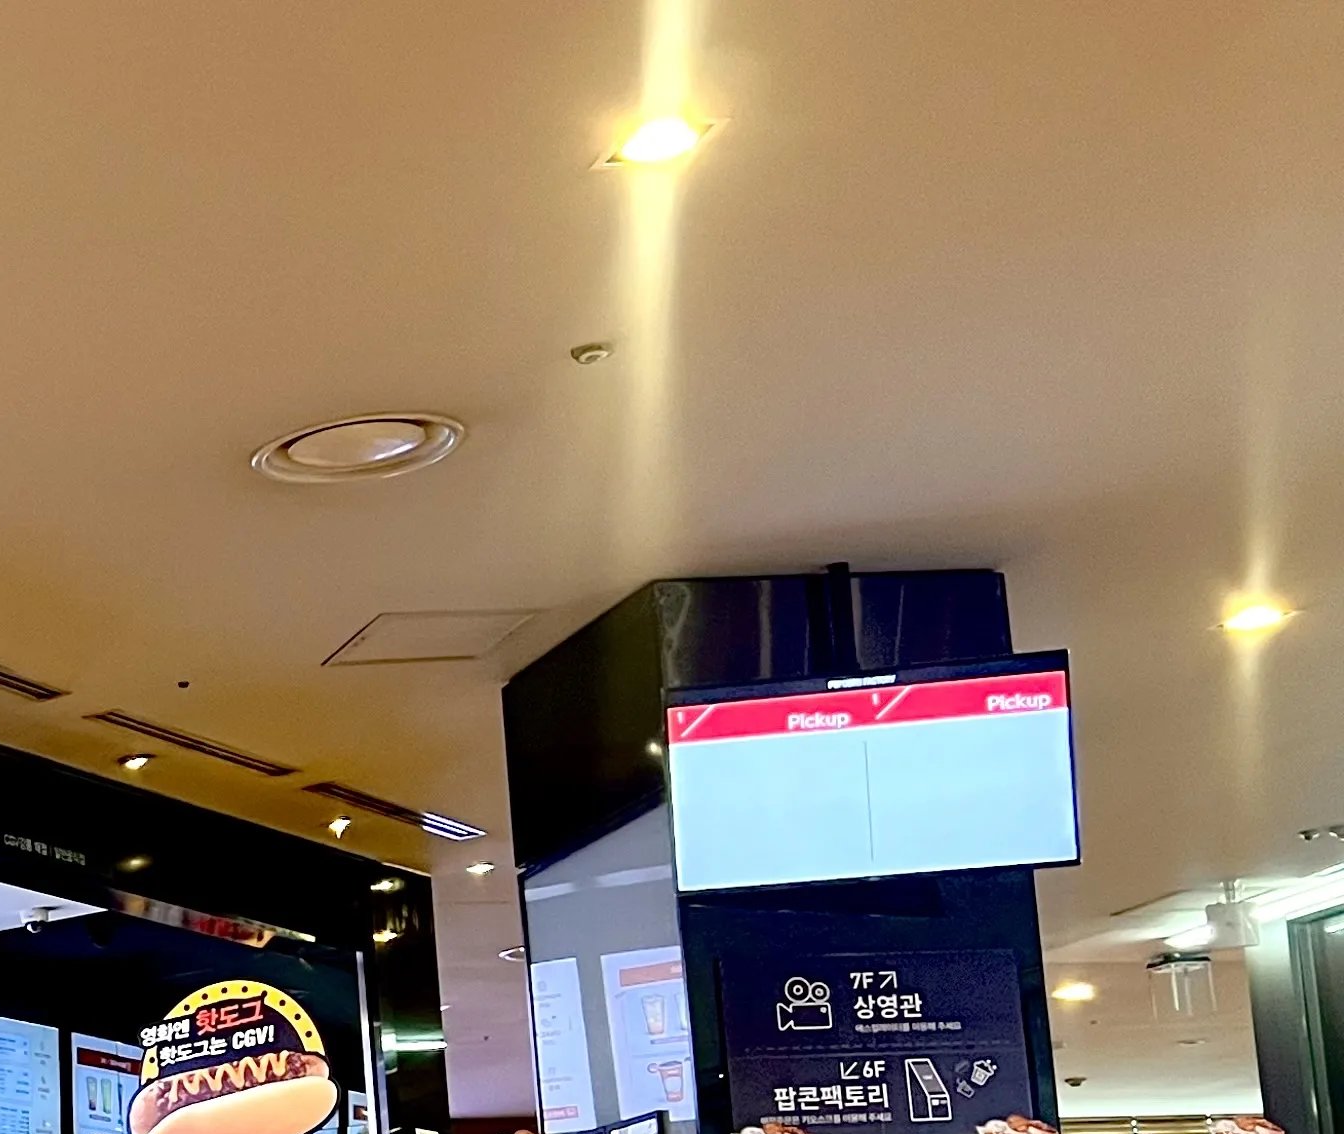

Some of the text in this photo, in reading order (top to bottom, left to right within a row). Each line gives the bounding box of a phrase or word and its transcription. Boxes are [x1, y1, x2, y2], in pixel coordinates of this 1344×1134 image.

[987, 692, 1051, 712] Pickup
[787, 711, 850, 731] Pickup
[849, 971, 873, 989] 7F
[853, 993, 923, 1020] 상영관
[140, 1000, 264, 1047] 영화엔 핫도그
[159, 1025, 275, 1067] 핫도그는 CGV!
[862, 1060, 886, 1078] 6F
[773, 1083, 889, 1112] 팝콘팩토리
